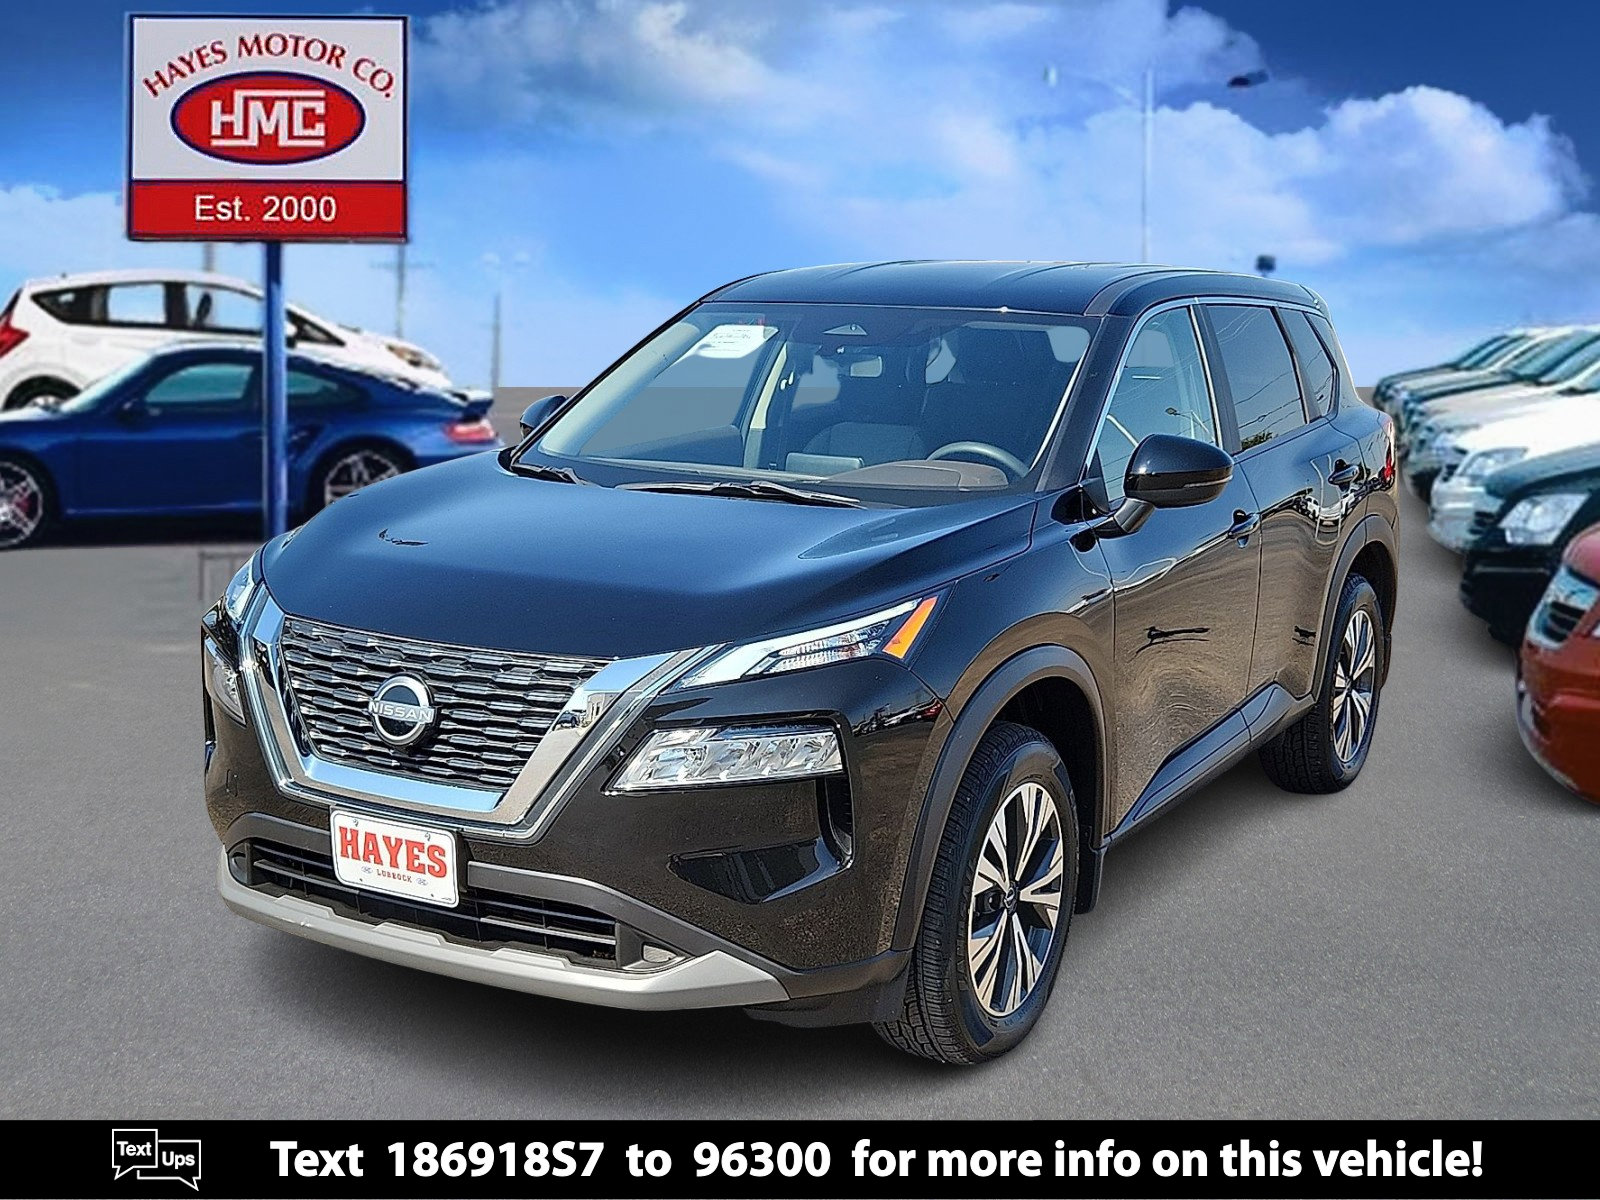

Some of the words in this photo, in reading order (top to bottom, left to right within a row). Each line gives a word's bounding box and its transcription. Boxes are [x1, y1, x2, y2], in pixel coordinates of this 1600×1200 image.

[143, 40, 228, 98] HAYES
[237, 33, 346, 69] MOTOR
[352, 57, 395, 99] CO.
[210, 88, 326, 147] HMC
[194, 194, 251, 222] Est.
[262, 195, 337, 222] 2000
[368, 700, 432, 720] NISSAN
[339, 825, 448, 879] HAYES
